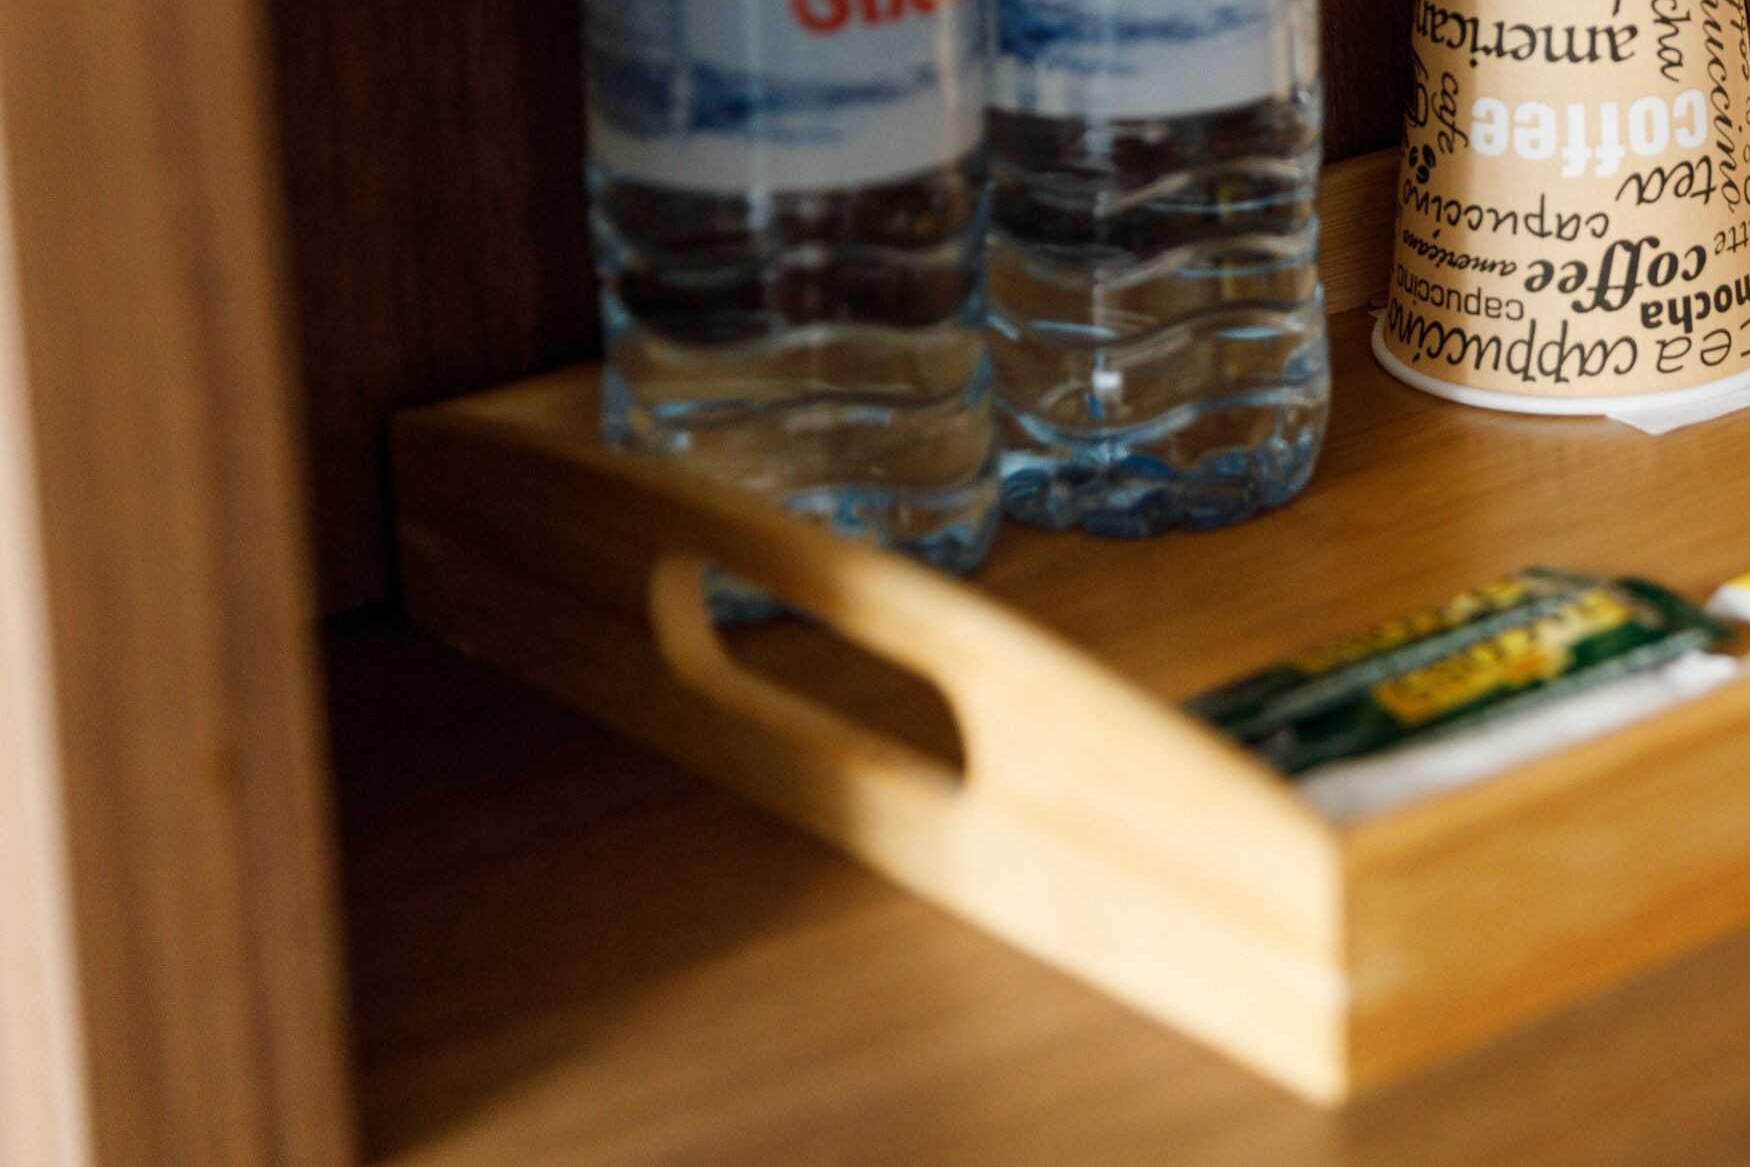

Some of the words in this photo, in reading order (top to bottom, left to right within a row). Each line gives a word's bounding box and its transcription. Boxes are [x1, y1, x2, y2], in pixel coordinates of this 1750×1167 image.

[1431, 71, 1469, 155] cafe
[1470, 88, 1709, 179] coffee
[1402, 178, 1610, 242] capuccino
[1616, 153, 1717, 205] tea
[1396, 263, 1525, 322] capuccino
[1524, 234, 1707, 314] coffee
[1388, 296, 1639, 384] cappuccino
